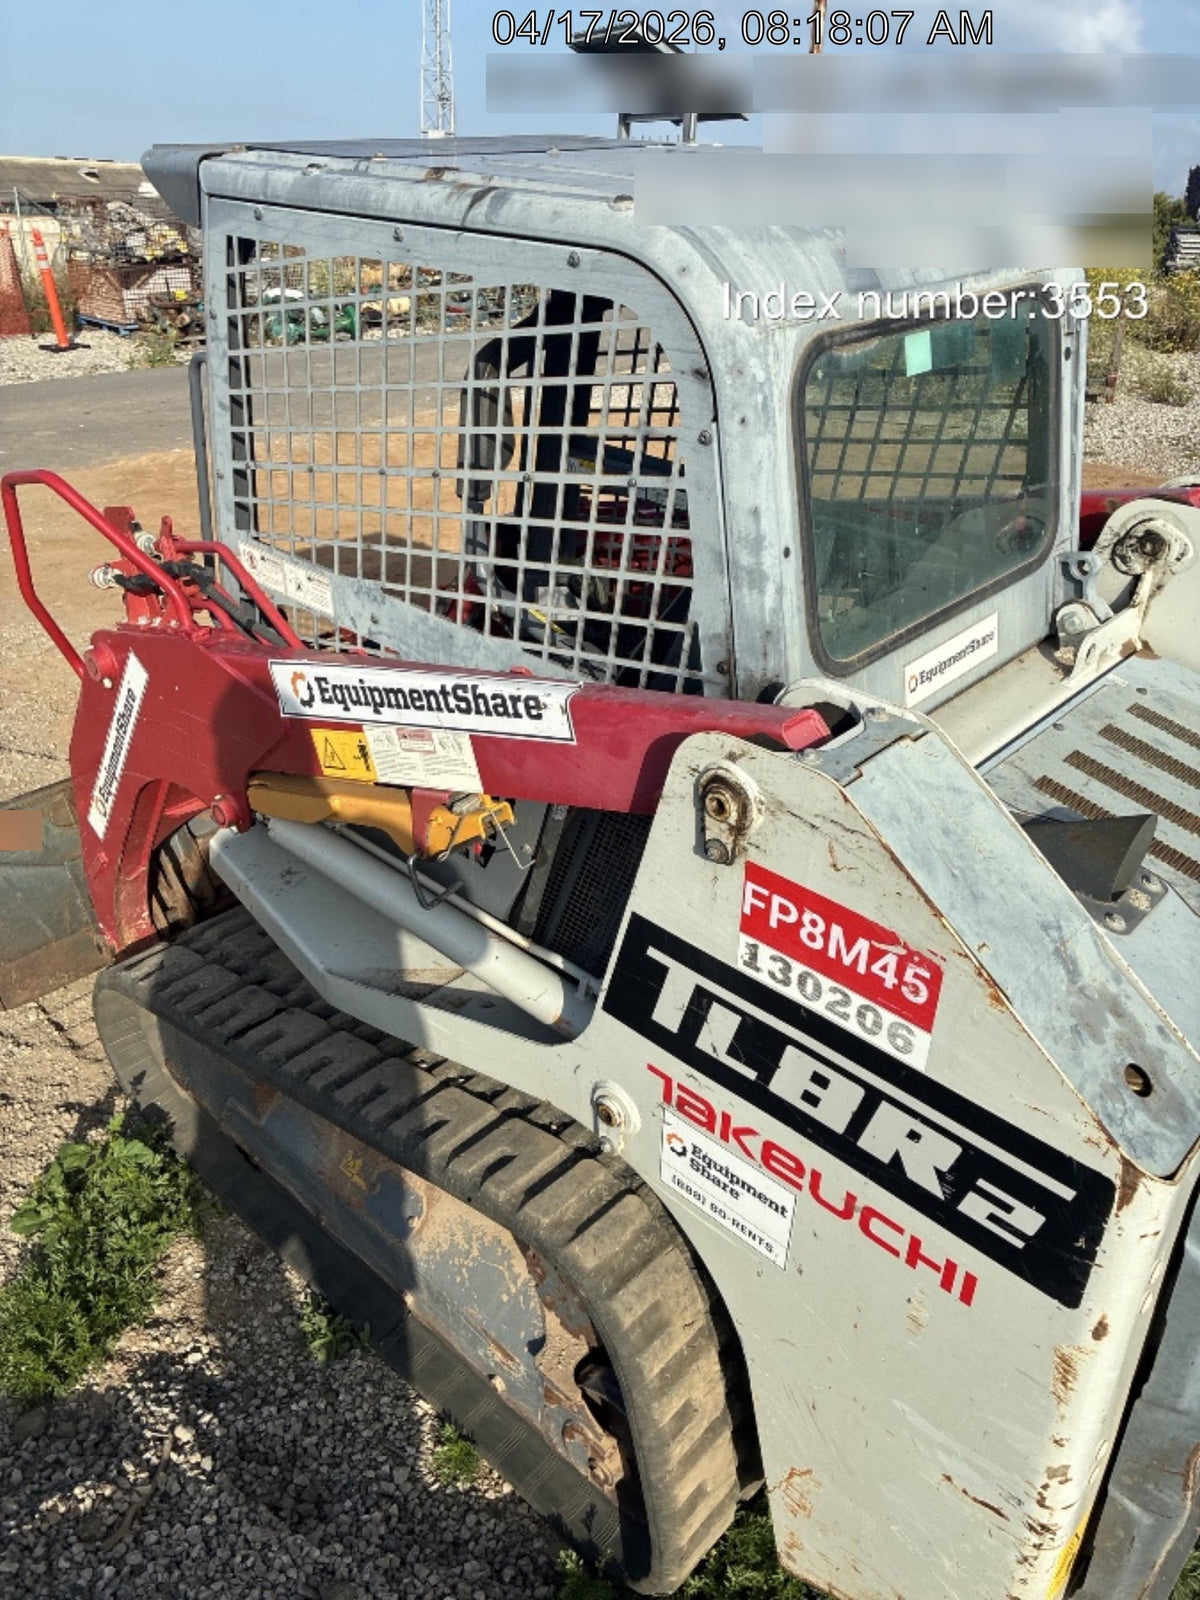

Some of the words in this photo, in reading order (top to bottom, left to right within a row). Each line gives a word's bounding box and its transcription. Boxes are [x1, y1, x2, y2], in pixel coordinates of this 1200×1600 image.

[98, 687, 137, 801] EquipmentShare
[314, 676, 544, 721] EquipmentShare
[742, 880, 931, 1005] FP8M45
[740, 941, 917, 1055] 130206
[689, 1157, 741, 1201] Share
[691, 1142, 789, 1219] Equipment
